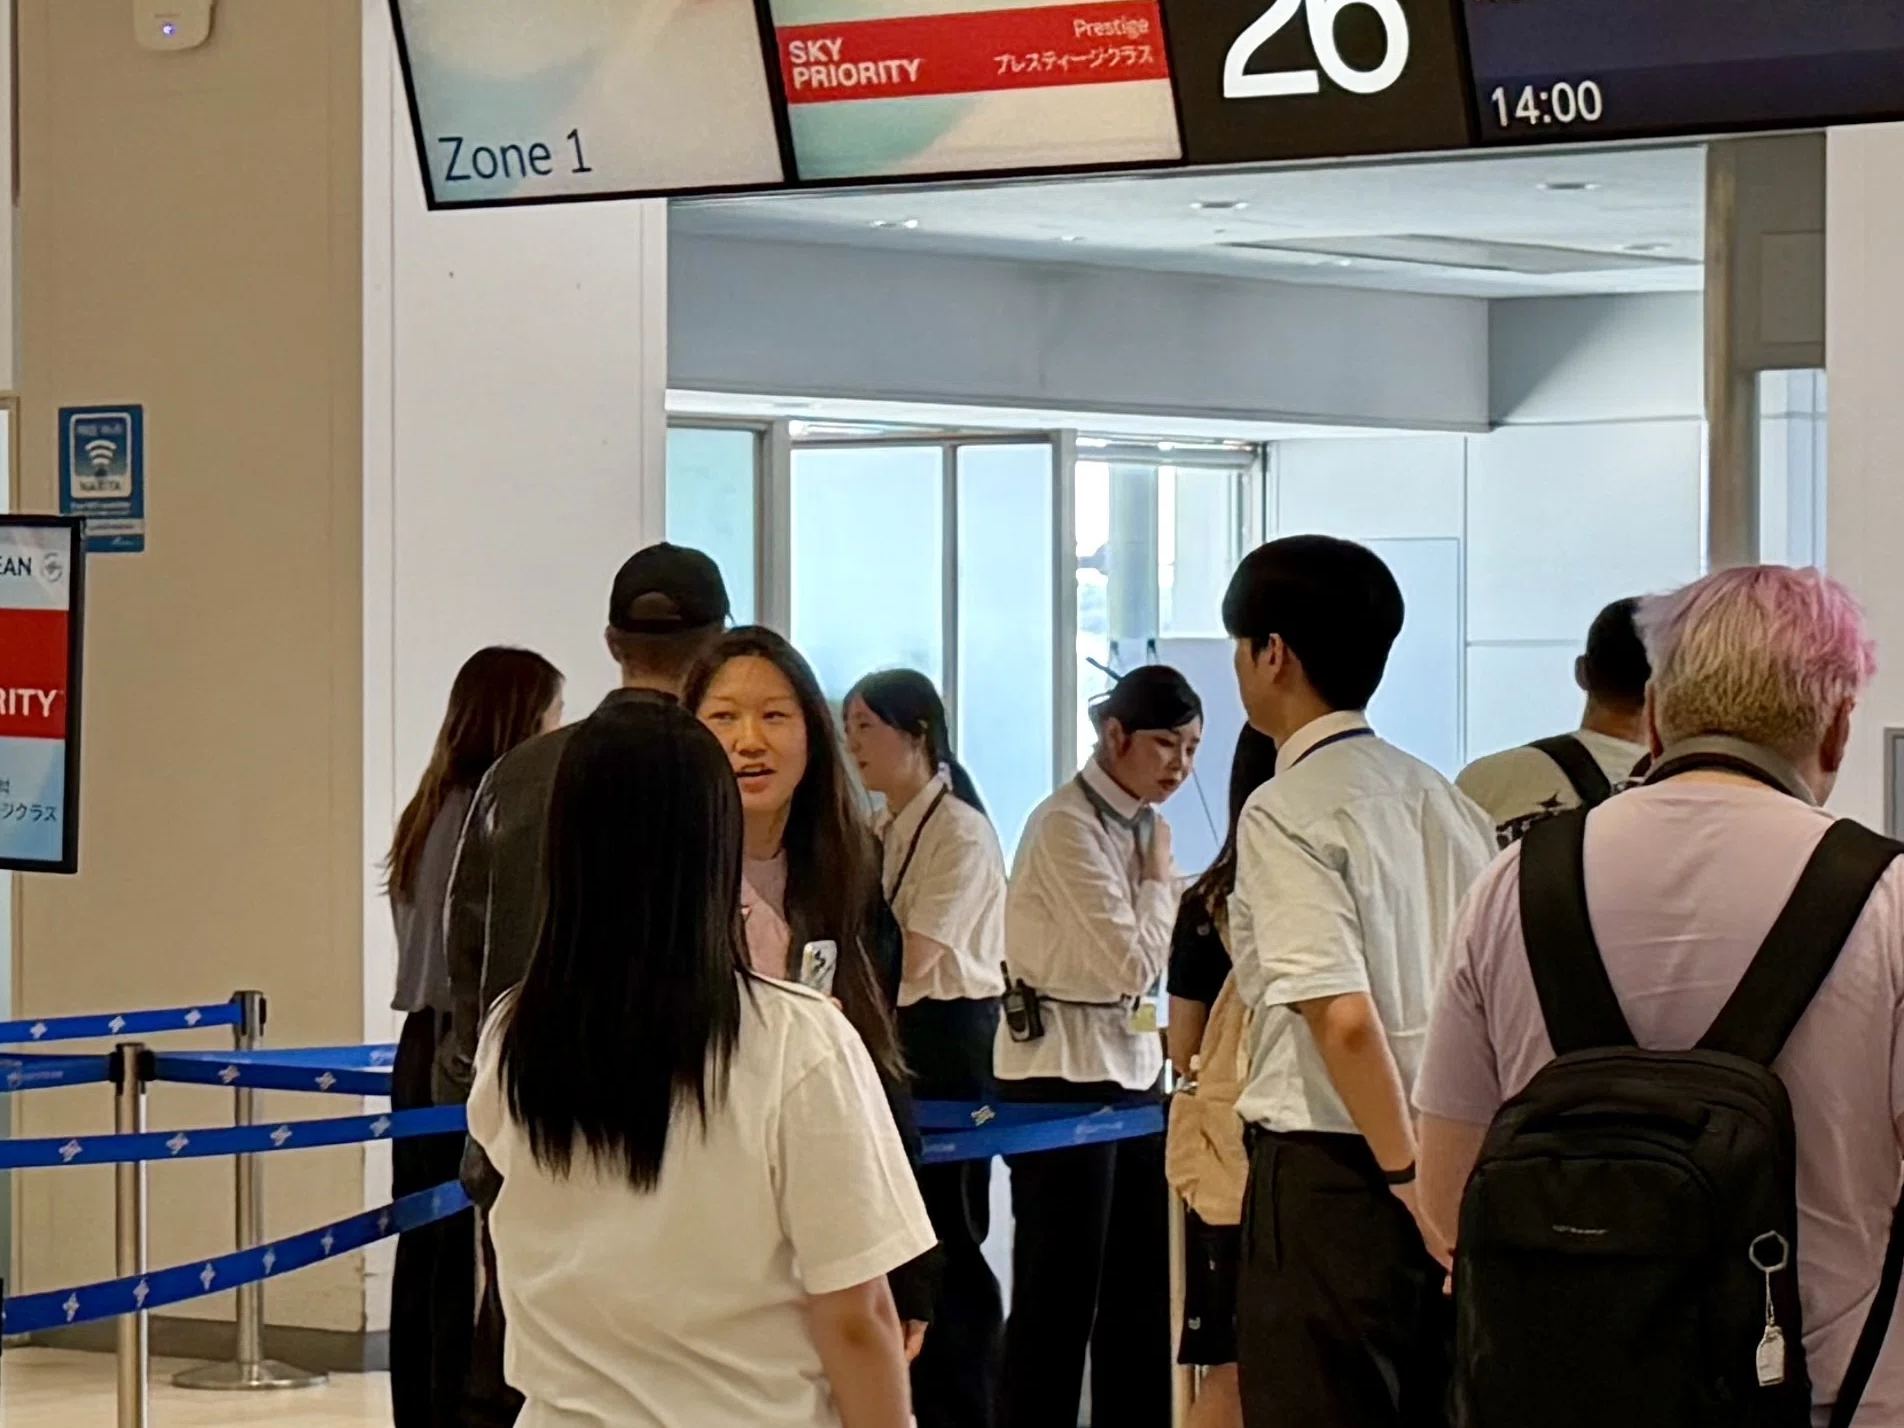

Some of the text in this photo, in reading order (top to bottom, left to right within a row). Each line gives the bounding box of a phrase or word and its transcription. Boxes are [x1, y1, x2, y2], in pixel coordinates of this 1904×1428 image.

[1072, 16, 1150, 40] Prestige
[788, 37, 844, 65] SKY
[792, 57, 921, 90] PRIORITY
[1492, 80, 1604, 127] 14:00
[437, 128, 593, 181] Zone 1
